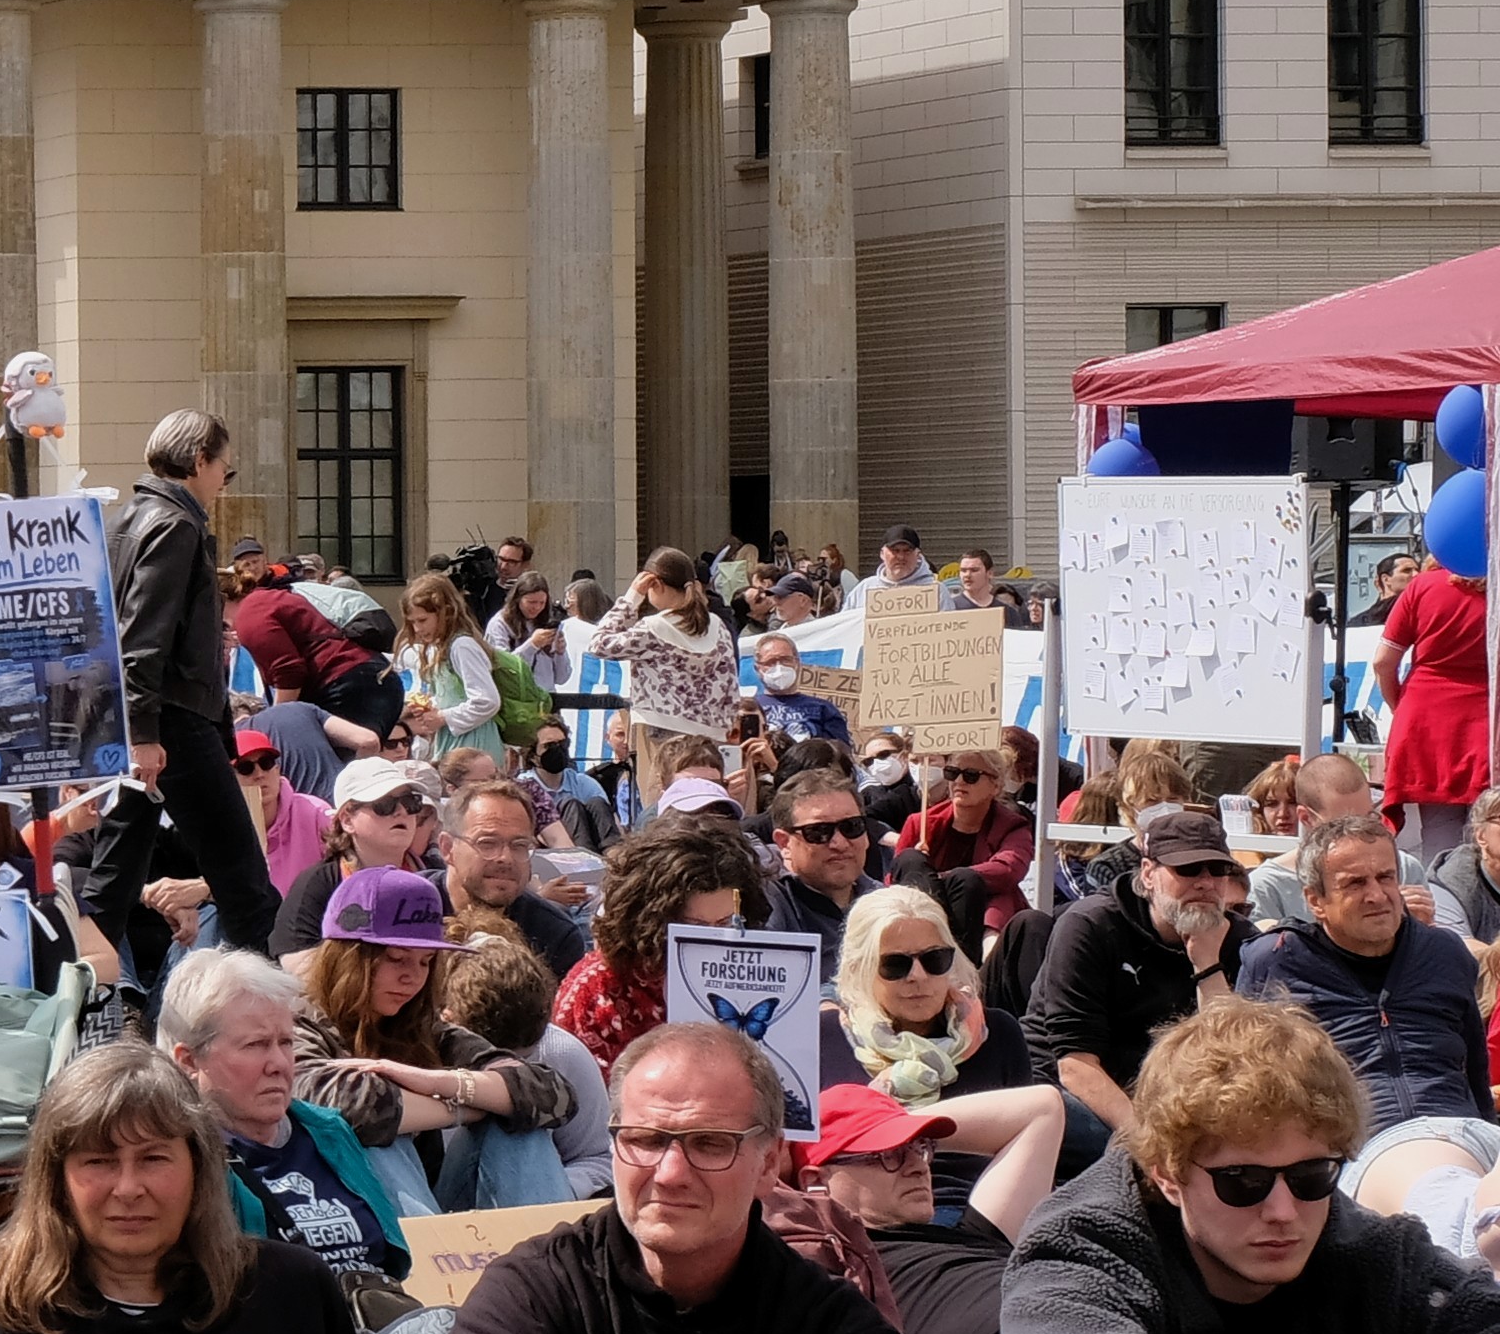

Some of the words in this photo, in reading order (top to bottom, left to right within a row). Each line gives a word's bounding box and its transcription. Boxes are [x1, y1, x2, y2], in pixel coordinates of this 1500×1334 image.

[1087, 491, 1112, 509] EURE
[1162, 492, 1176, 511] AN
[1200, 492, 1265, 513] VERSORGUNG
[6, 505, 91, 554] krank
[19, 548, 80, 580] Leben
[878, 634, 1002, 664] FORTBILDUNGEN
[800, 667, 830, 692] DIE
[838, 674, 860, 693] ZE
[908, 661, 952, 685] ALLE
[722, 949, 764, 965] JETZT
[701, 961, 787, 983] FORSCHUNG
[704, 979, 723, 989] JETZT
